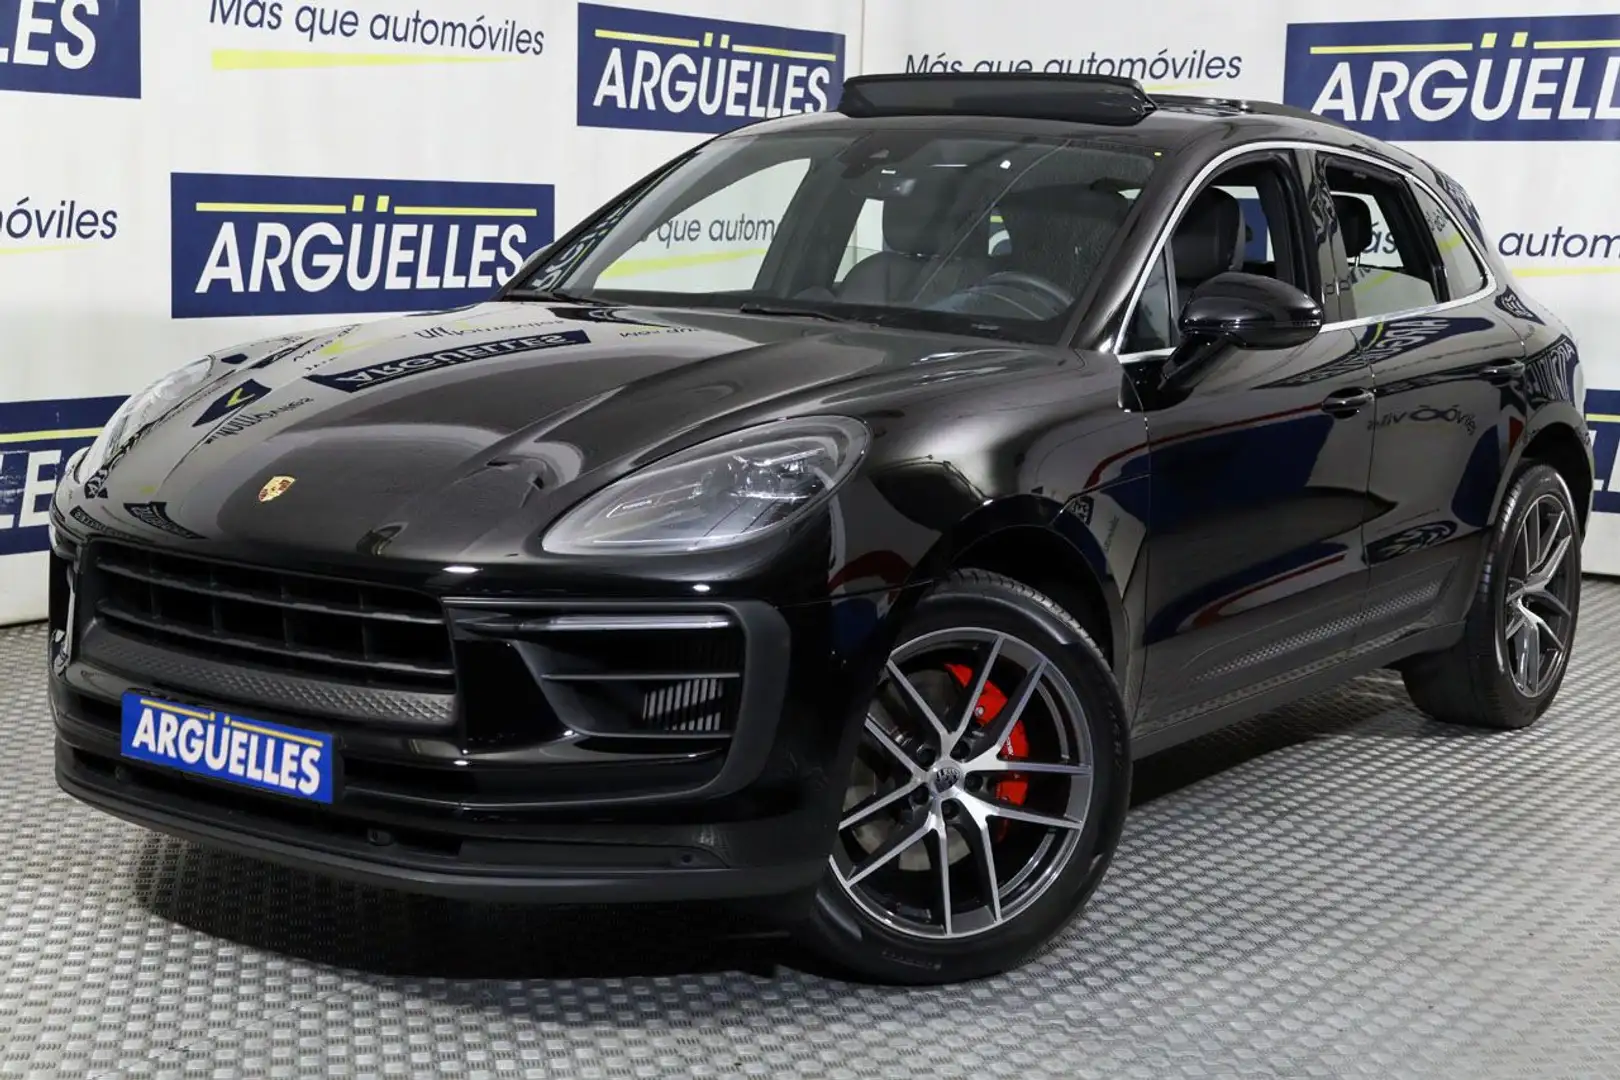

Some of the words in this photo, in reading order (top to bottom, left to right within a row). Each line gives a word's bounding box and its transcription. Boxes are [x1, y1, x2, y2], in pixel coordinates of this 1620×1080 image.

[295, 5, 359, 42] que
[369, 10, 544, 55] automóviles
[593, 32, 830, 118] ARGÜELLES
[905, 52, 962, 73] Más
[1043, 48, 1242, 80] automóviles
[0, 196, 118, 239] óviles
[657, 219, 701, 249] que
[195, 195, 527, 293] ARGÜELLES
[132, 708, 321, 795] ARGÜELLES
